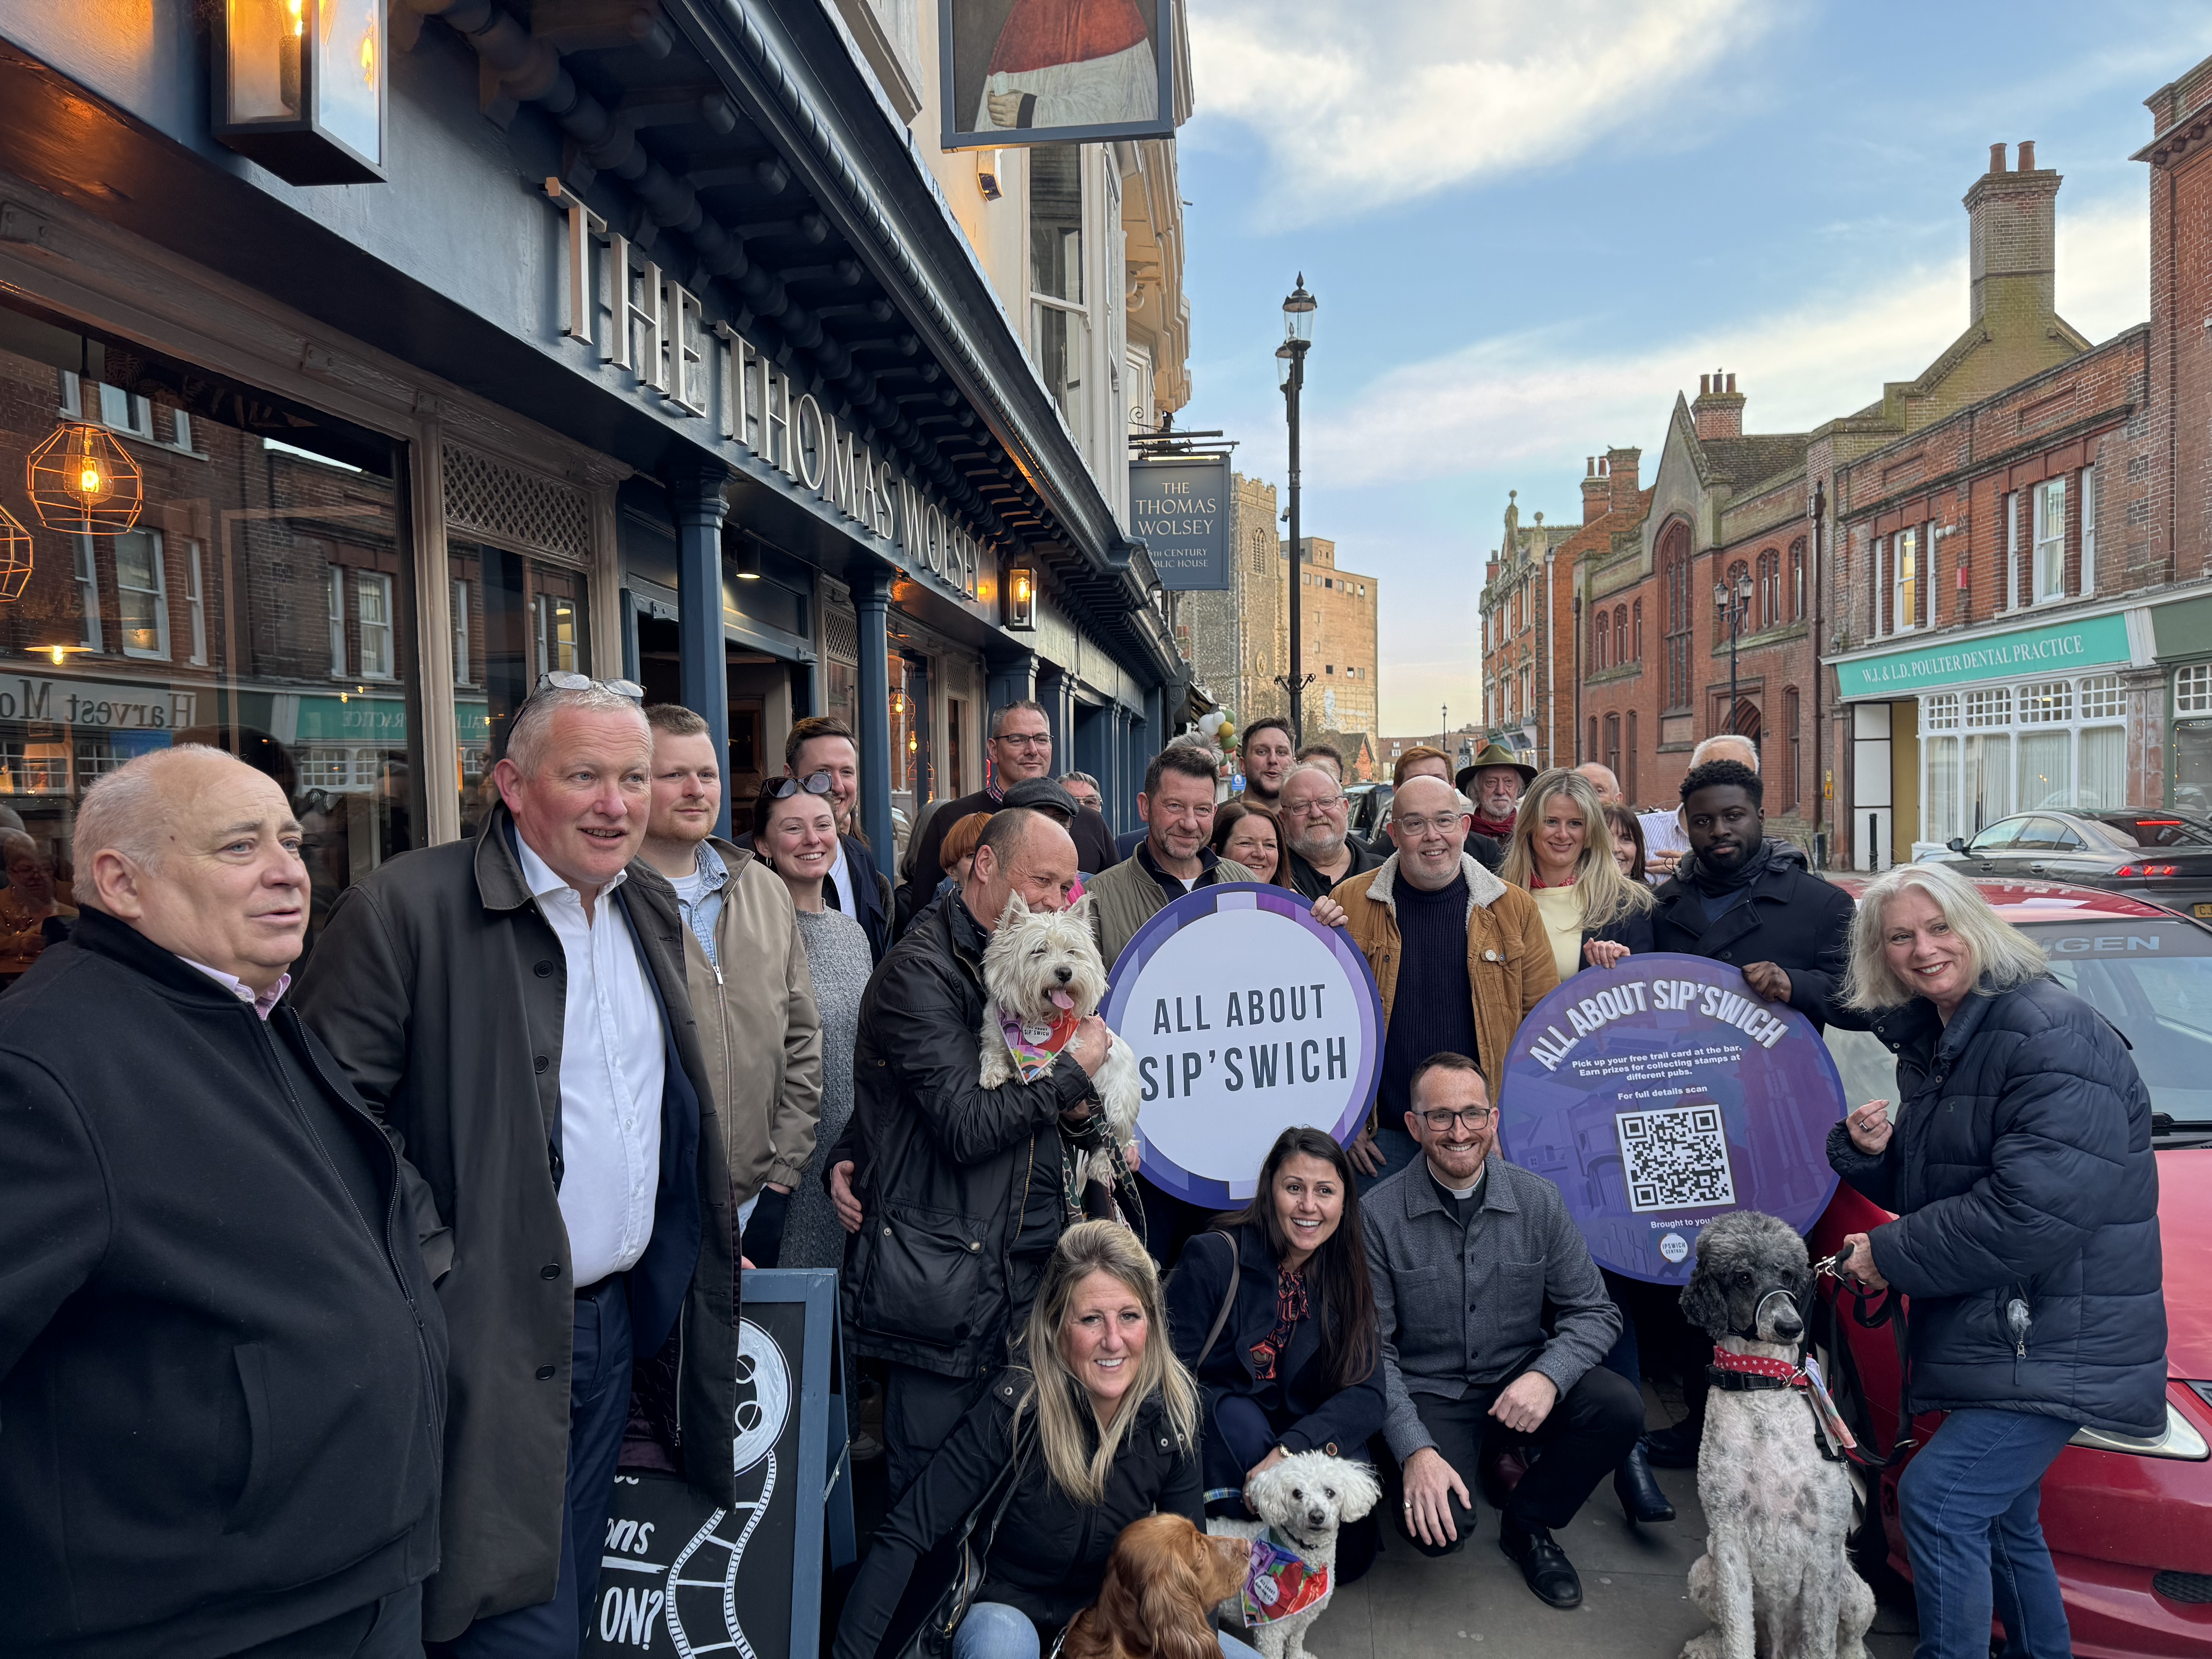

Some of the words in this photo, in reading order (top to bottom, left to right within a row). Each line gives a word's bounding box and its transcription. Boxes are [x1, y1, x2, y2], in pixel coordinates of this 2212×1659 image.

[544, 177, 707, 418] THE
[716, 320, 894, 540] THOMAS
[897, 476, 982, 603] WOLSEY
[1162, 483, 1190, 494] THE
[1135, 498, 1216, 514] THOMAS
[1138, 520, 1213, 535] WOLSEY
[1882, 666, 1890, 681] &
[1891, 664, 1910, 679] L.D.
[1911, 655, 1962, 677] POULTER
[1963, 646, 2011, 669] DENTAL
[2013, 635, 2084, 662] PRACTICE
[1153, 994, 1211, 1035] ALL
[1226, 984, 1326, 1028] ABOUT
[1530, 1025, 1579, 1072] ALL
[1566, 981, 1647, 1038] ABOUT
[1653, 979, 1790, 1049] SIP'SWICH
[1572, 1060, 1592, 1068] Pick
[1594, 1059, 1605, 1067] up
[1607, 1057, 1627, 1066] your
[1629, 1054, 1648, 1063] free
[1650, 1051, 1669, 1060] trail
[1671, 1049, 1692, 1058] card
[1580, 1068, 1600, 1077] Earn
[1602, 1065, 1630, 1075] prizes
[1632, 1063, 1644, 1072] for
[1647, 1058, 1692, 1070] collecting
[1694, 1055, 1728, 1065] stamps
[1139, 1036, 1348, 1102] SIP'SWICH
[1626, 1071, 1665, 1081] different
[1668, 1068, 1692, 1078] pubs.
[1618, 1092, 1633, 1100] For
[1635, 1090, 1649, 1098] full
[1652, 1087, 1683, 1097] details
[1685, 1085, 1708, 1094] scan
[1650, 1219, 1683, 1228] Brought
[1695, 1218, 1710, 1226] you
[600, 1587, 664, 1650] ON?
